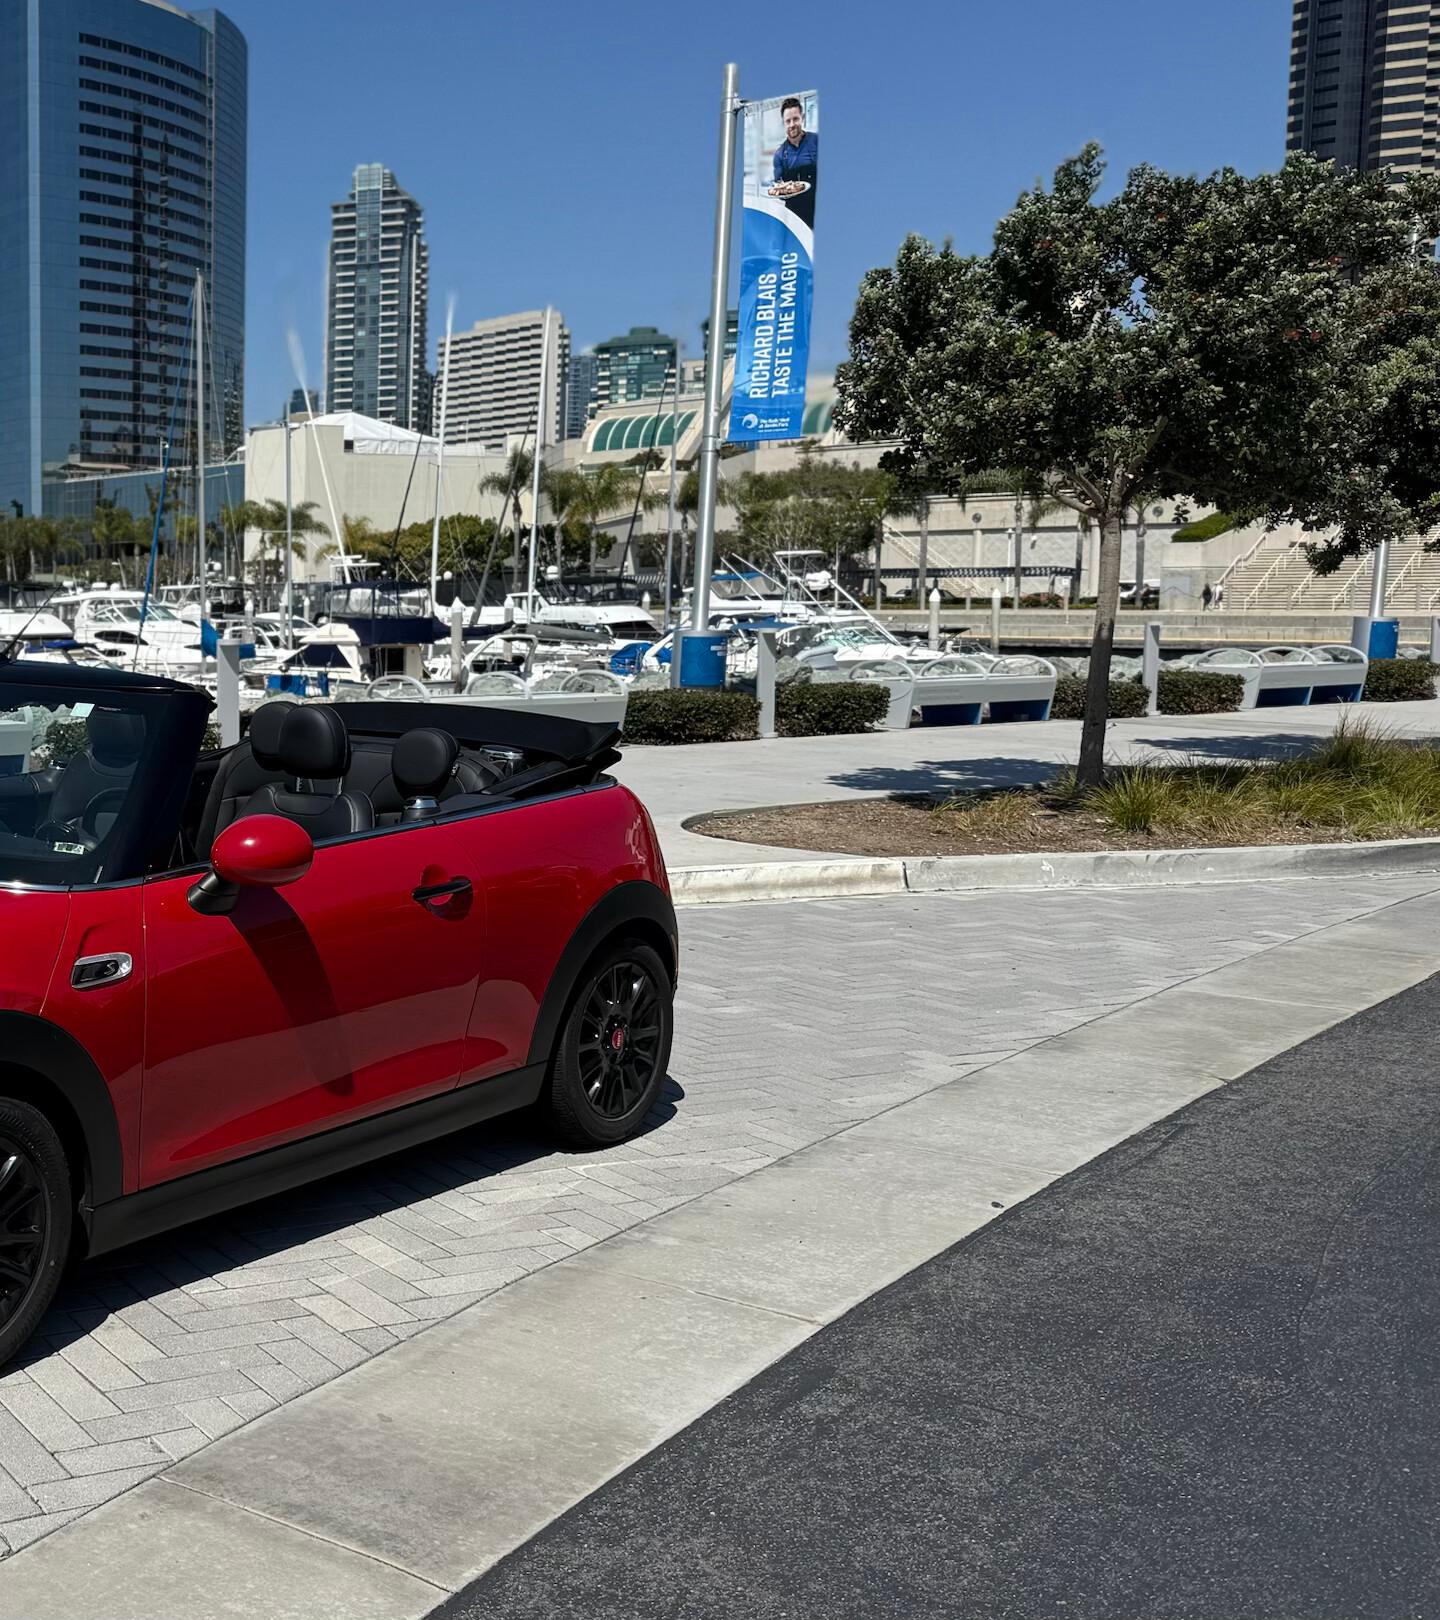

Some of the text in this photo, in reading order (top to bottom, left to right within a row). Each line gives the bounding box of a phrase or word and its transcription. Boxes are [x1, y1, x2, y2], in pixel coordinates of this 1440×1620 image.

[756, 273, 778, 322] BLAIS
[779, 252, 799, 308] MAGIC
[776, 311, 796, 344] THE
[749, 325, 774, 399] RICHARD
[771, 346, 793, 399] TASTE
